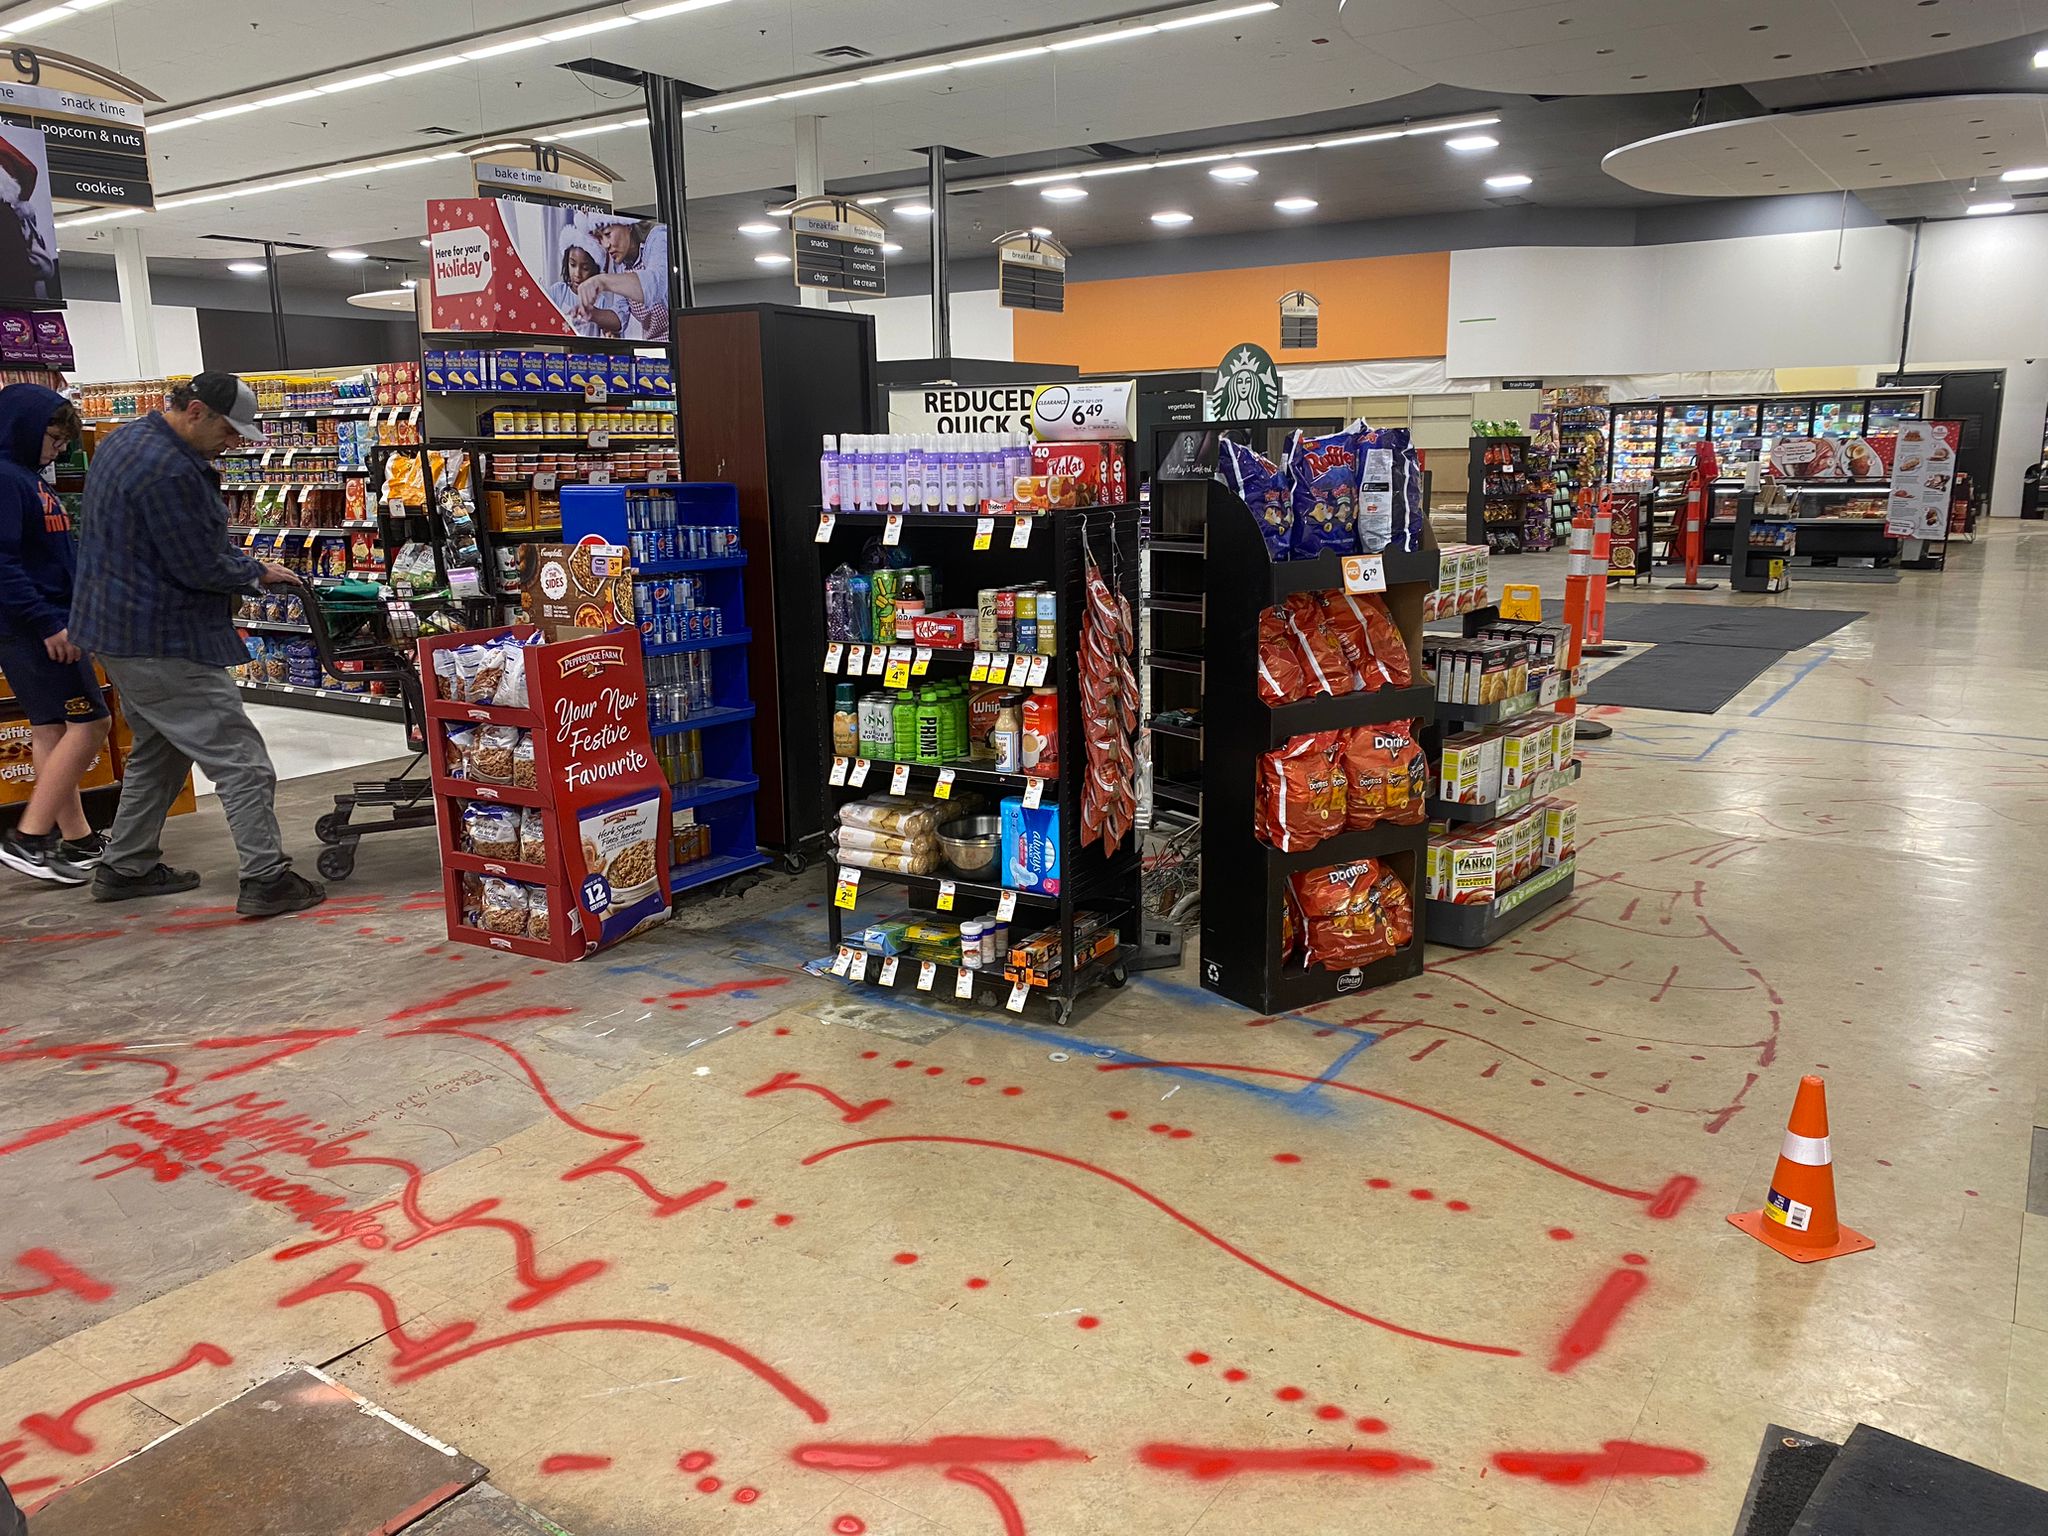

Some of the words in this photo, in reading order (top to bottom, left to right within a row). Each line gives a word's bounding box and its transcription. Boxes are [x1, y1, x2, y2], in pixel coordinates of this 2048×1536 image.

[13, 48, 40, 85] 9
[62, 96, 96, 112] snack
[100, 102, 126, 117] time
[41, 123, 97, 140] popcorn
[100, 131, 110, 142] &
[113, 133, 141, 147] nuts
[530, 144, 559, 174] 10
[495, 168, 519, 180] bake
[522, 172, 542, 183] time
[76, 180, 125, 197] cookies
[570, 179, 587, 192] bake
[588, 183, 602, 194] time
[502, 192, 528, 204] candy
[832, 200, 848, 223] 11
[808, 220, 840, 232] breakfast
[810, 239, 830, 249] snacks
[853, 245, 874, 256] desserts
[1028, 233, 1041, 254] 12
[435, 247, 453, 260] Here
[453, 246, 464, 257] for
[464, 245, 482, 257] your
[436, 257, 482, 280] Holiday
[853, 262, 877, 272] novelties
[814, 272, 829, 283] chips
[853, 277, 862, 286] ice
[862, 279, 877, 288] cream
[924, 389, 1035, 414] REDUCED
[1038, 399, 1067, 407] CLEARANCE
[1167, 402, 1196, 412] vegetables
[937, 414, 1011, 436] QUICK
[1171, 414, 1192, 422] entrees
[1034, 447, 1049, 458] 40
[987, 503, 1007, 511] Trident
[545, 577, 565, 590] SIDES
[997, 600, 1014, 608] evia
[564, 652, 601, 671] PEPPERIDGE
[601, 649, 619, 661] FARM
[555, 697, 597, 742] Your
[600, 687, 639, 722] New
[570, 723, 631, 759] Festive
[919, 716, 939, 758] PRIME
[564, 750, 648, 793] Favourite
[614, 816, 648, 837] Seasoned
[621, 828, 643, 841] herbes
[1032, 830, 1043, 874] always
[1458, 856, 1492, 871] PANKO
[1329, 863, 1369, 886] Doritos
[585, 883, 607, 906] 12
